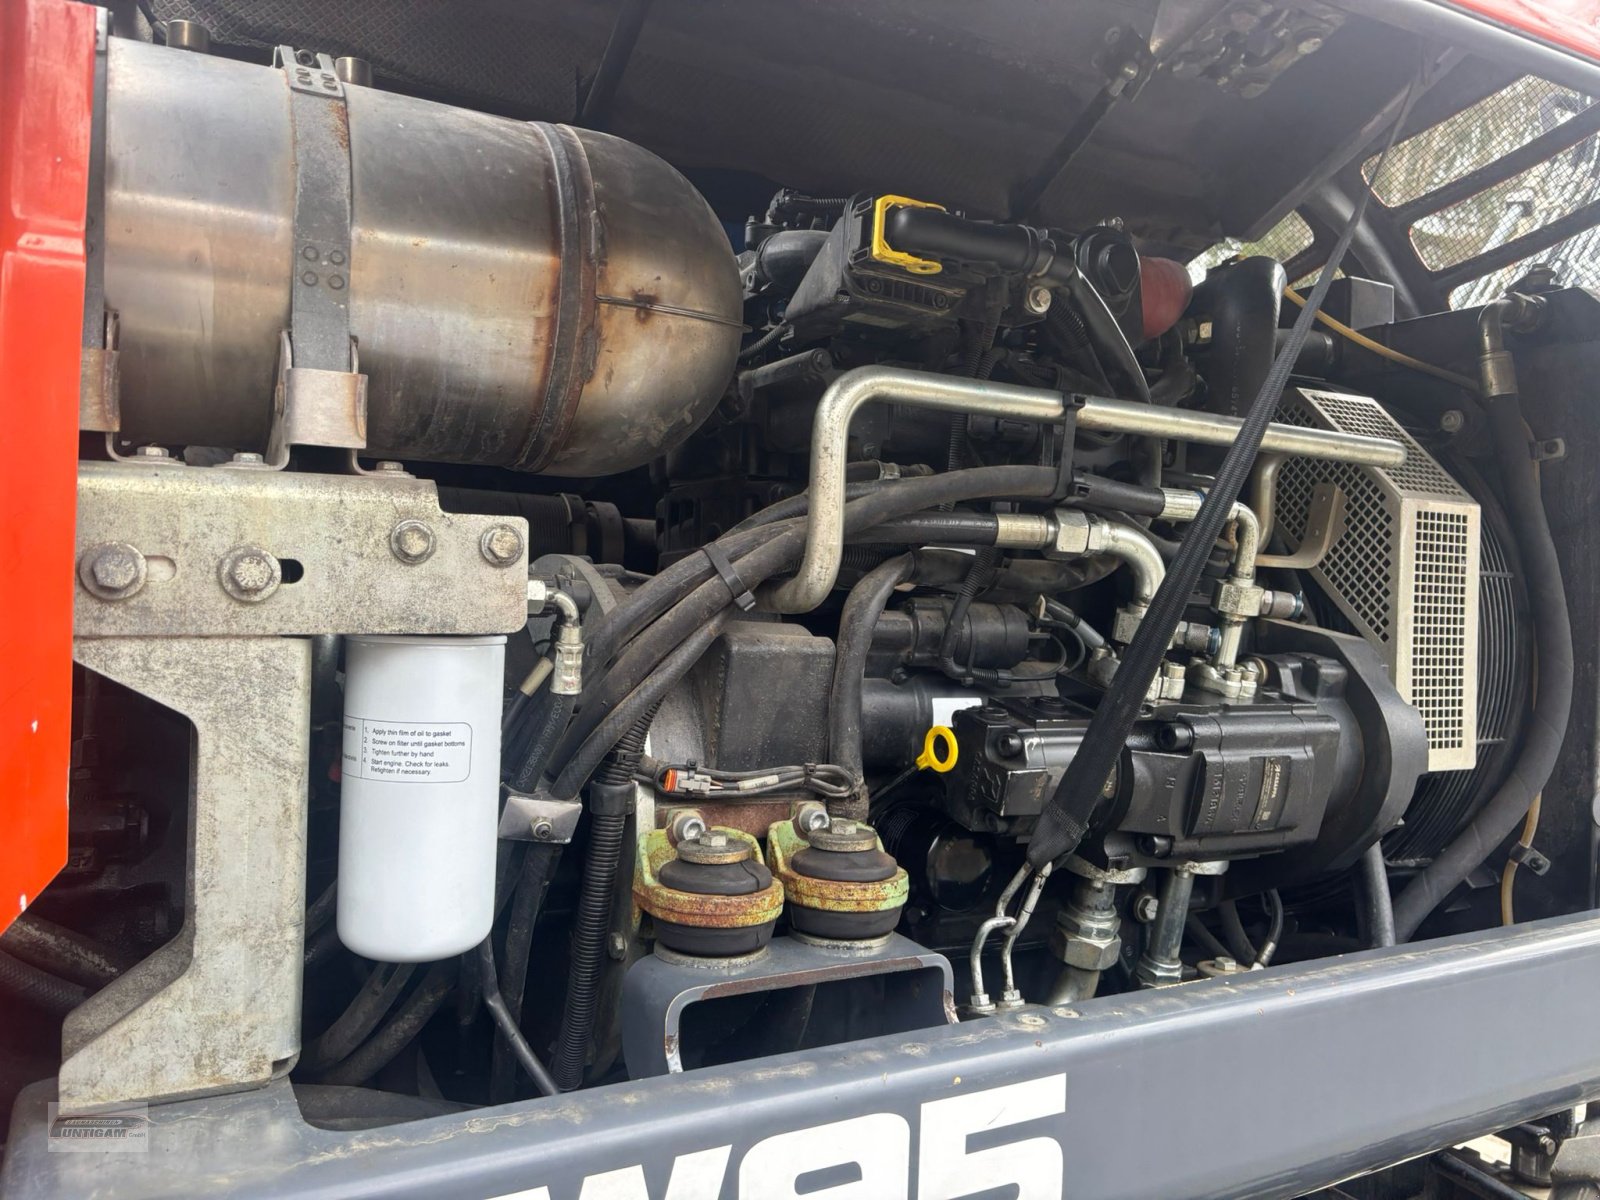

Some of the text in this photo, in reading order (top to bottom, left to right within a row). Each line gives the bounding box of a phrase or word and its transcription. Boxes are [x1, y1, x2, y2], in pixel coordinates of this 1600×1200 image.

[372, 728, 386, 736] Apply
[372, 748, 390, 756] Tighten
[371, 766, 395, 774] Retighten
